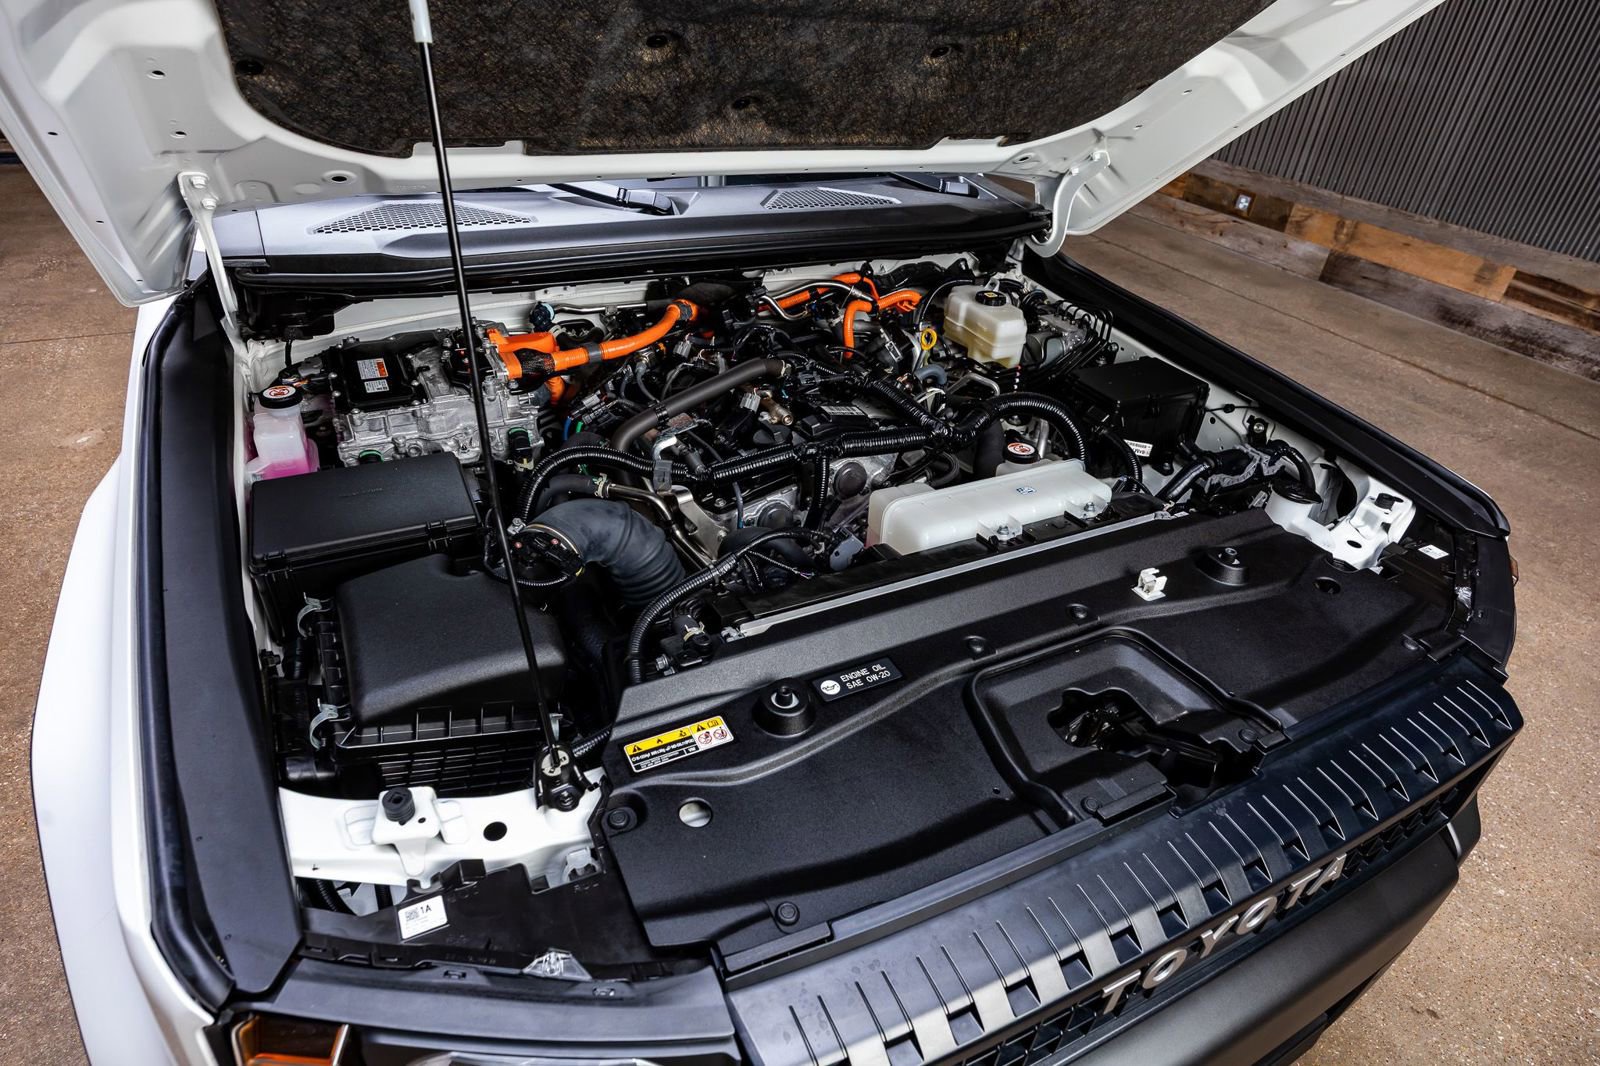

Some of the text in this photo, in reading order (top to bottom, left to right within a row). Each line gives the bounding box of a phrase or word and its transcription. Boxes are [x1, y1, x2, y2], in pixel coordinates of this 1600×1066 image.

[840, 663, 886, 682] ENGINE OIL
[846, 670, 891, 689] SAE 0W-20
[420, 904, 432, 914] 1A
[1102, 853, 1347, 1015] TOYOTA
